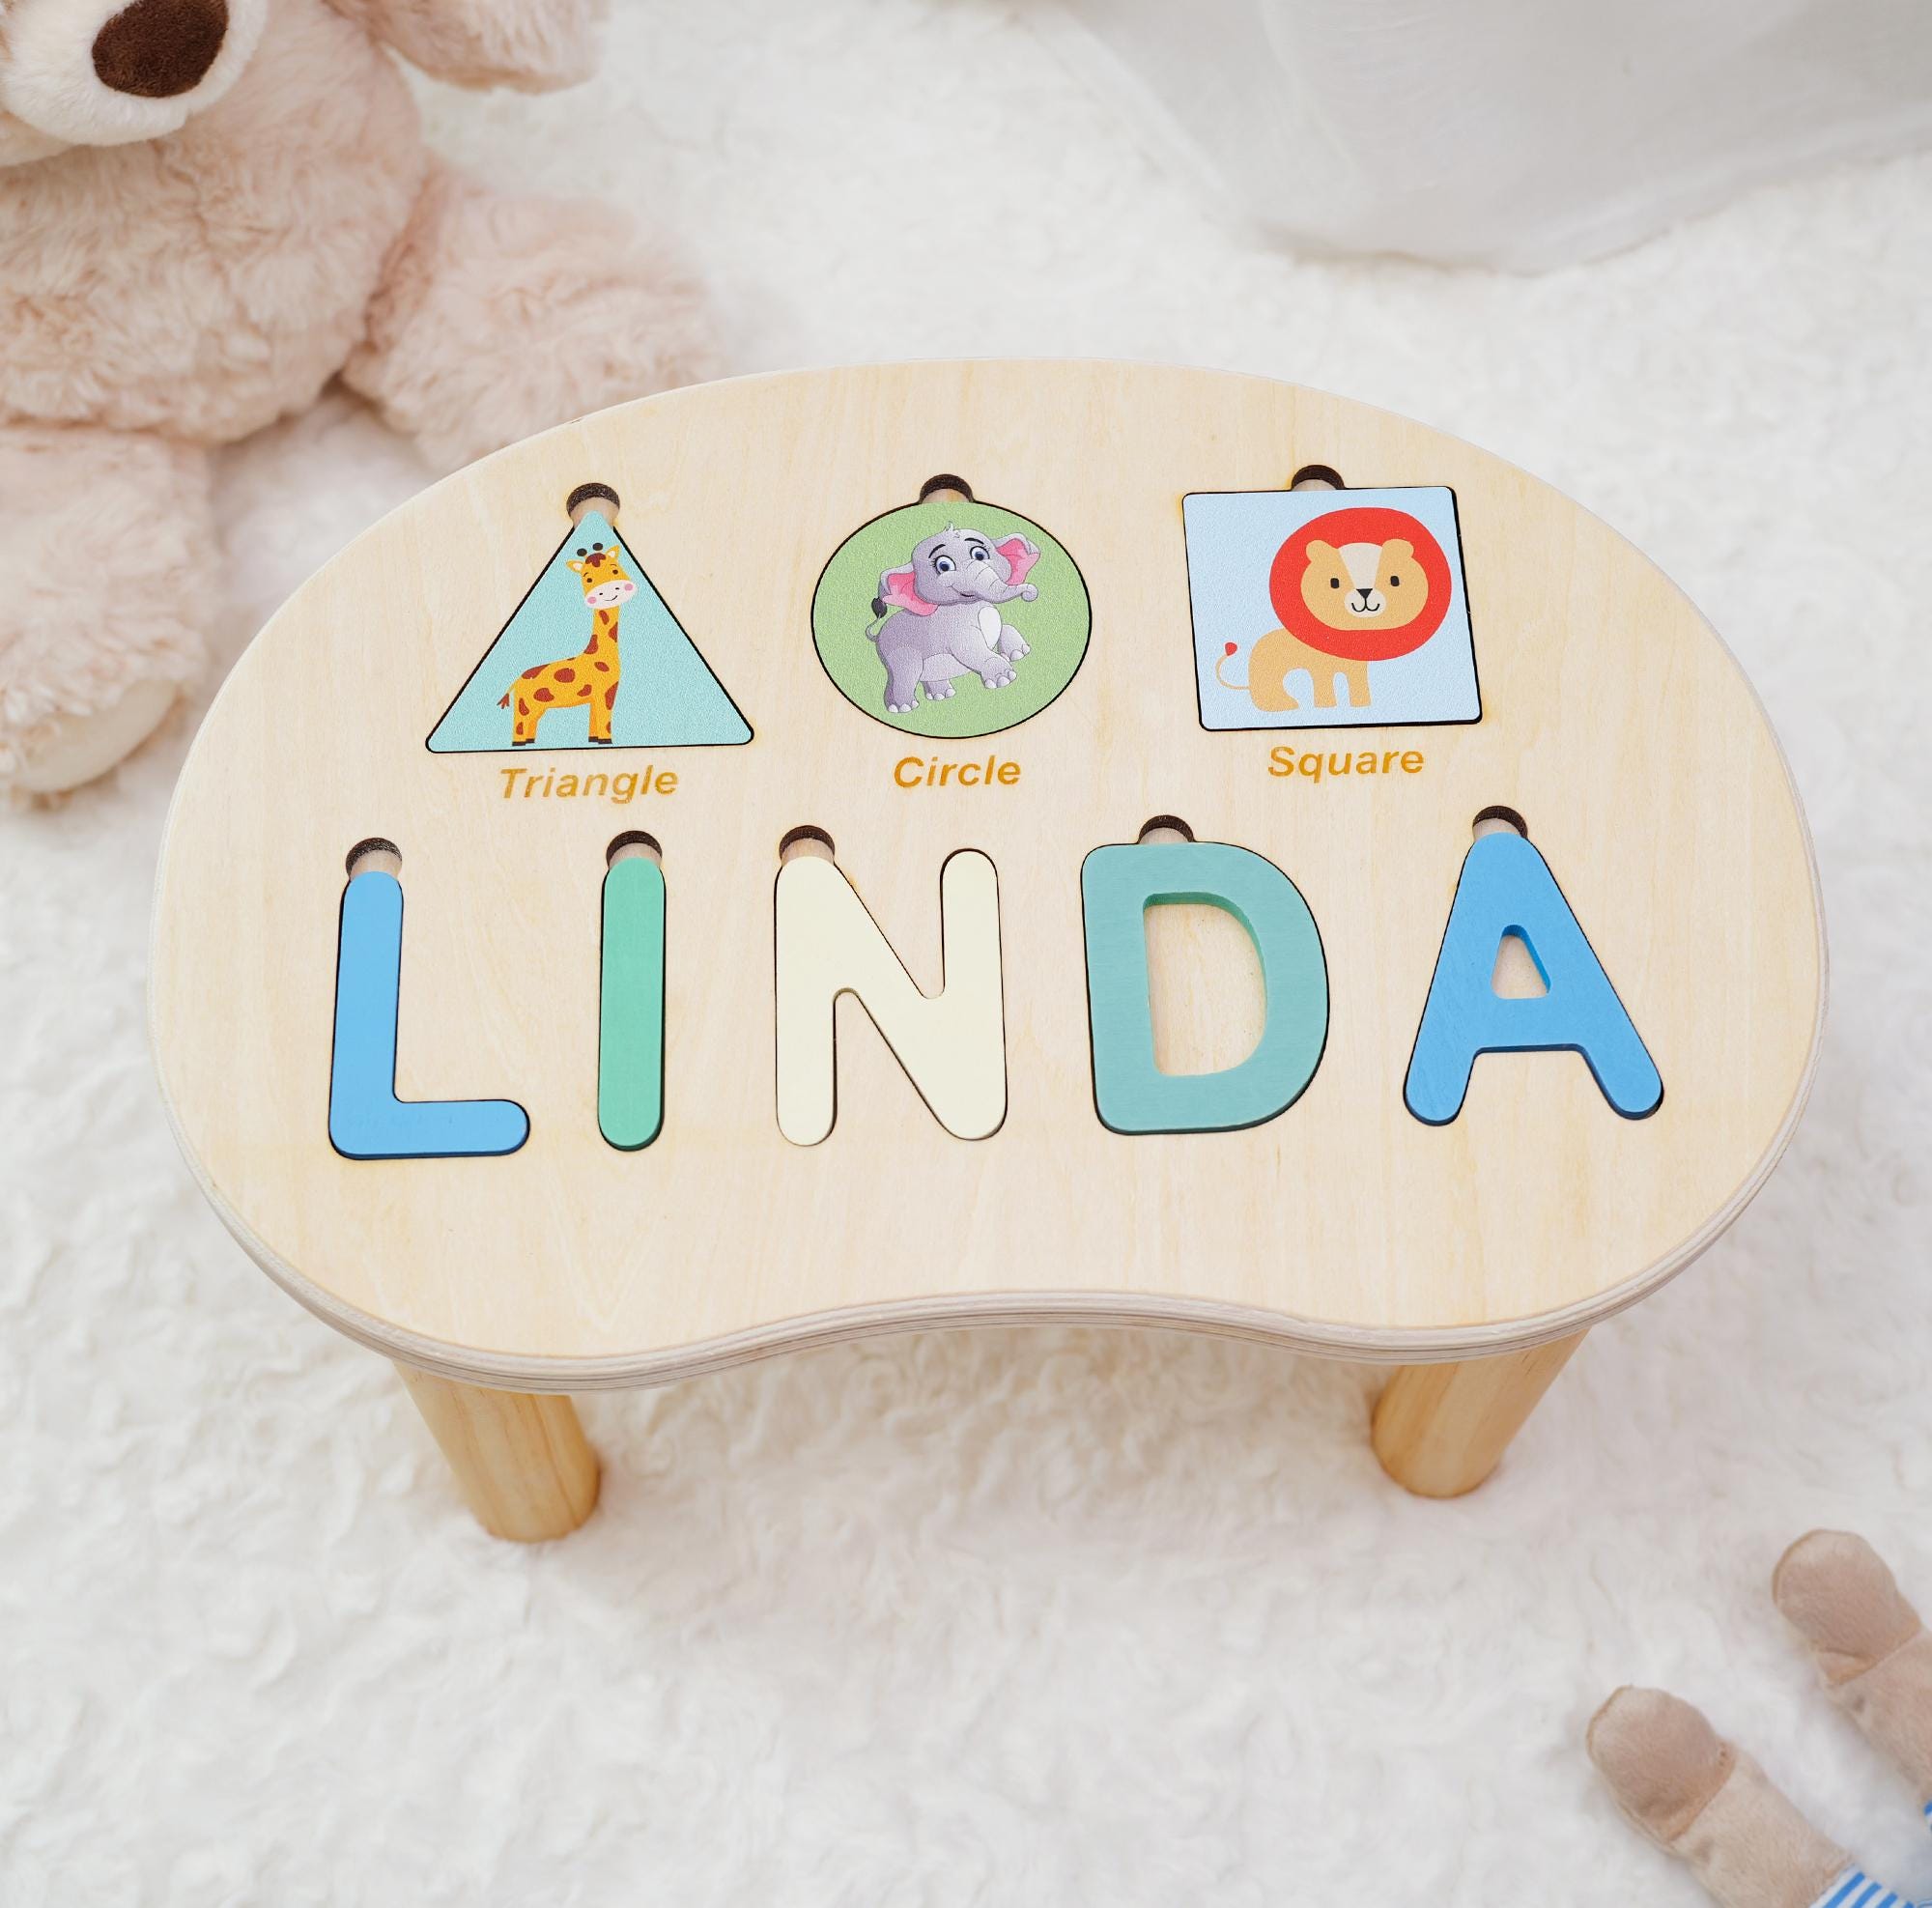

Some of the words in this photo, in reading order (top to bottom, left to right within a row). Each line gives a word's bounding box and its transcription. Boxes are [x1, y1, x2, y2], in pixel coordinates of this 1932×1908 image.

[893, 755, 1021, 788] Circle
[1267, 746, 1425, 783] Square
[500, 764, 679, 804] Triangle
[328, 833, 1663, 1158] LINDA
